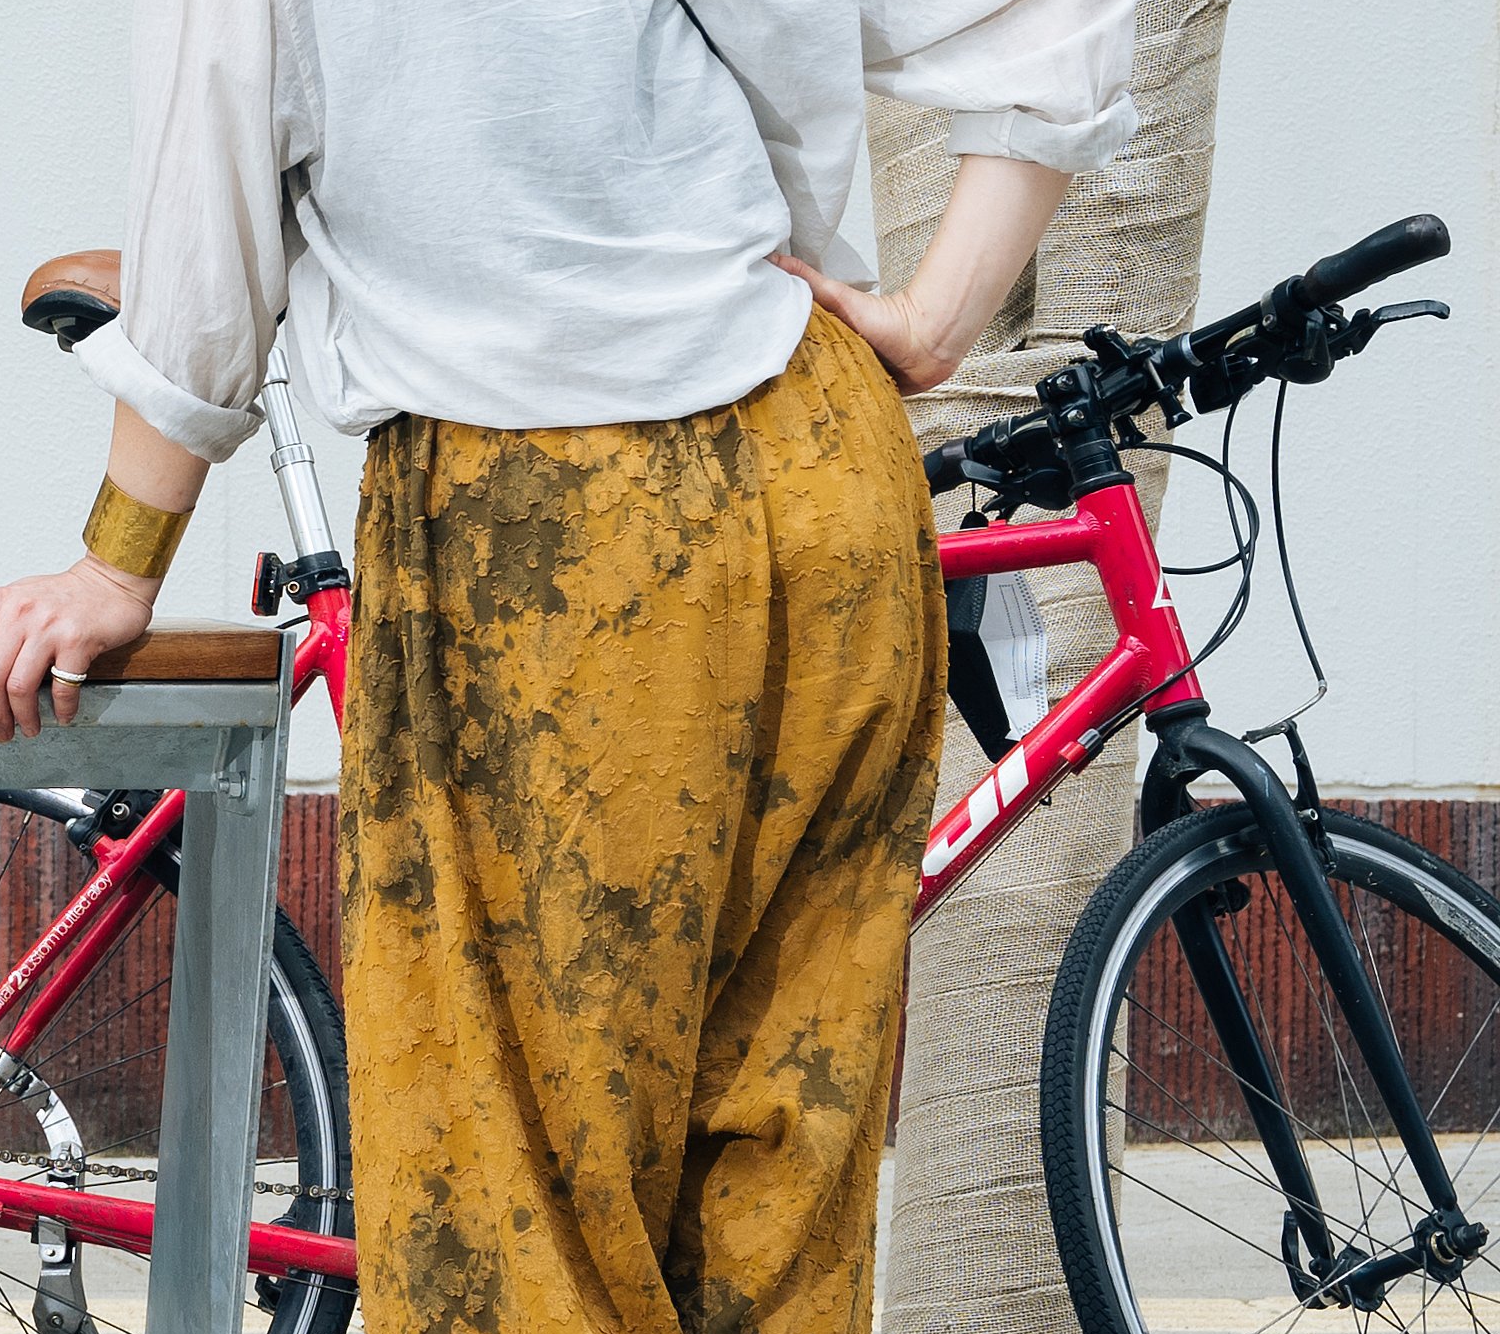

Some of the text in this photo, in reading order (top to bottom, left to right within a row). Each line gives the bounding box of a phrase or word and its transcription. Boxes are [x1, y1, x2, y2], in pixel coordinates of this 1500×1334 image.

[7, 970, 29, 991] 2
[20, 931, 61, 978] custom
[86, 872, 114, 902] alloy
